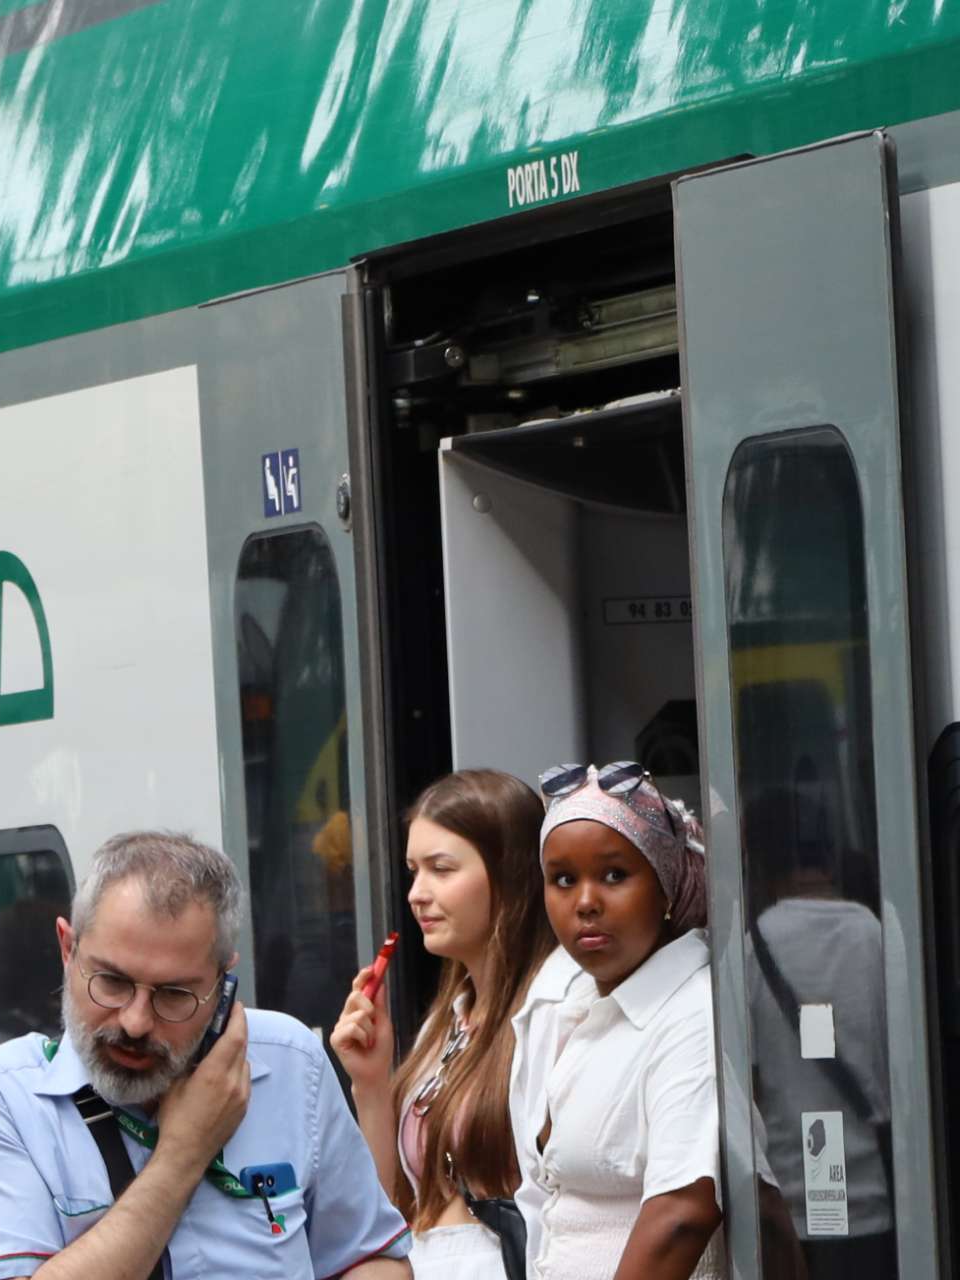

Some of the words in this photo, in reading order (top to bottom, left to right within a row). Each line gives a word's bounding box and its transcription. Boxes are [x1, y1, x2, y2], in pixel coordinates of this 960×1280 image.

[507, 159, 549, 208] PORTA
[550, 156, 558, 198] 5
[560, 151, 580, 194] DX
[680, 600, 692, 617] 0
